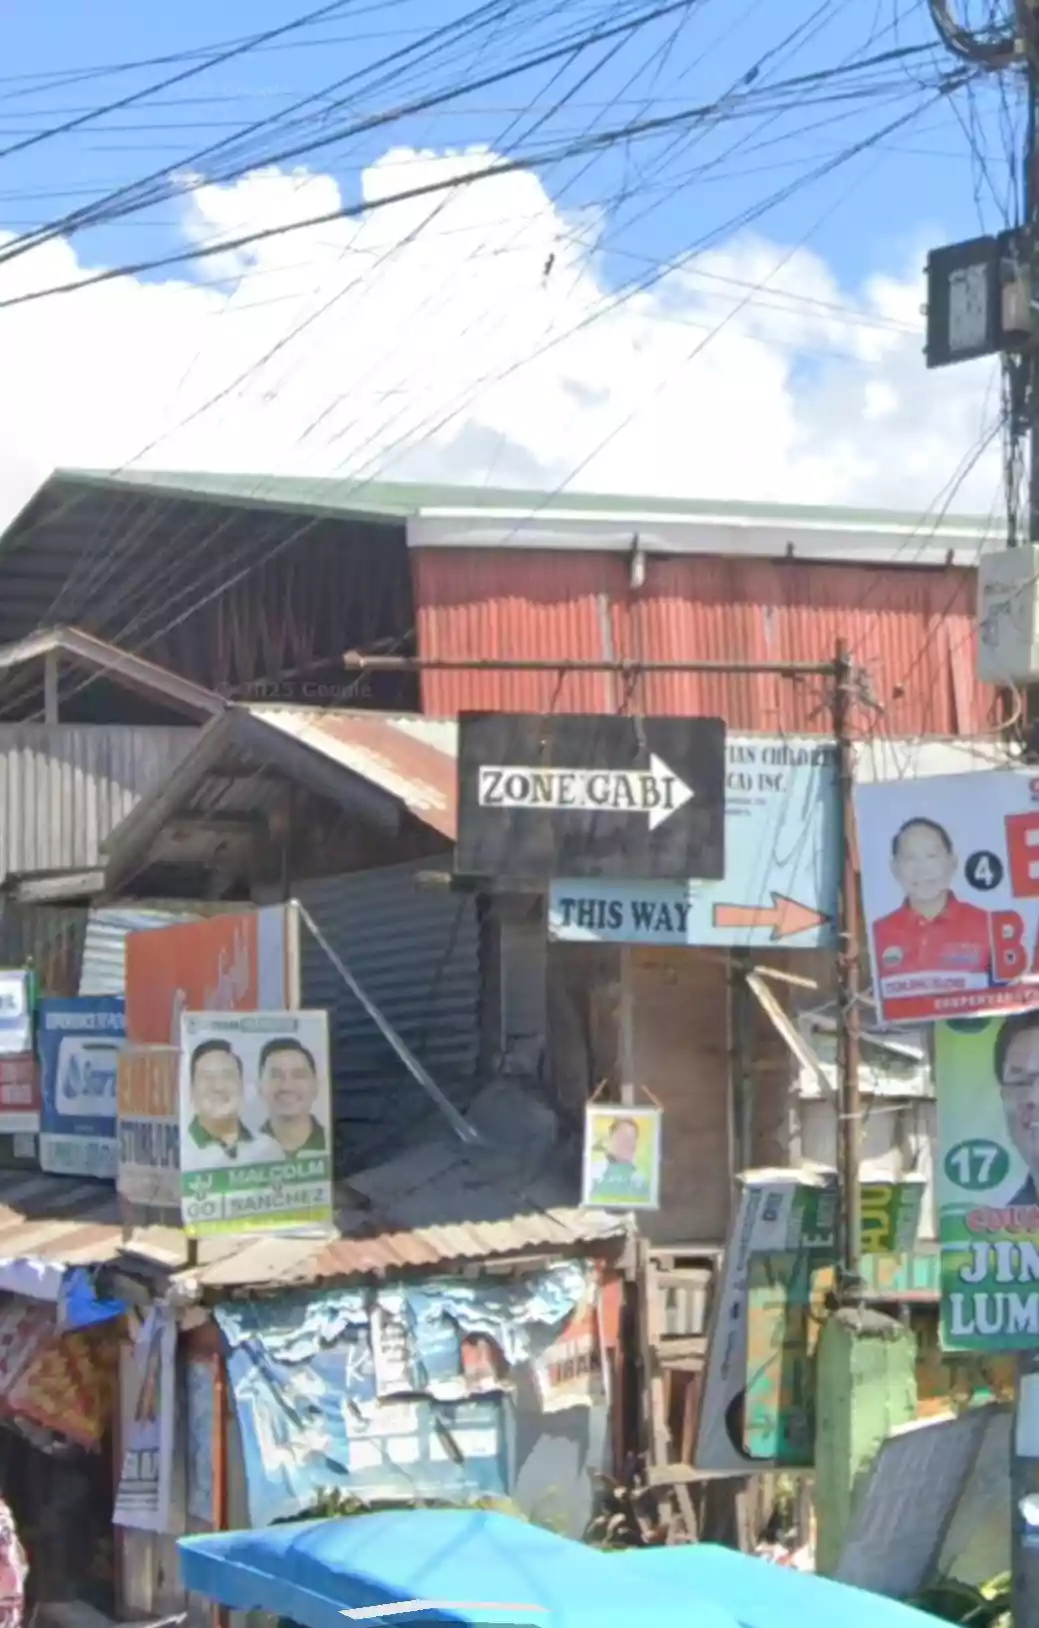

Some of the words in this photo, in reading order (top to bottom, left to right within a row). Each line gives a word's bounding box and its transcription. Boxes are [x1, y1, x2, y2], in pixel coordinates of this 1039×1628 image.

[481, 770, 576, 804] ZONE
[586, 772, 678, 809] GABI
[972, 855, 995, 887] 4
[559, 897, 623, 930] THIS
[630, 899, 693, 933] WAY
[950, 1146, 998, 1185] 17
[949, 1291, 1039, 1335] LUM
